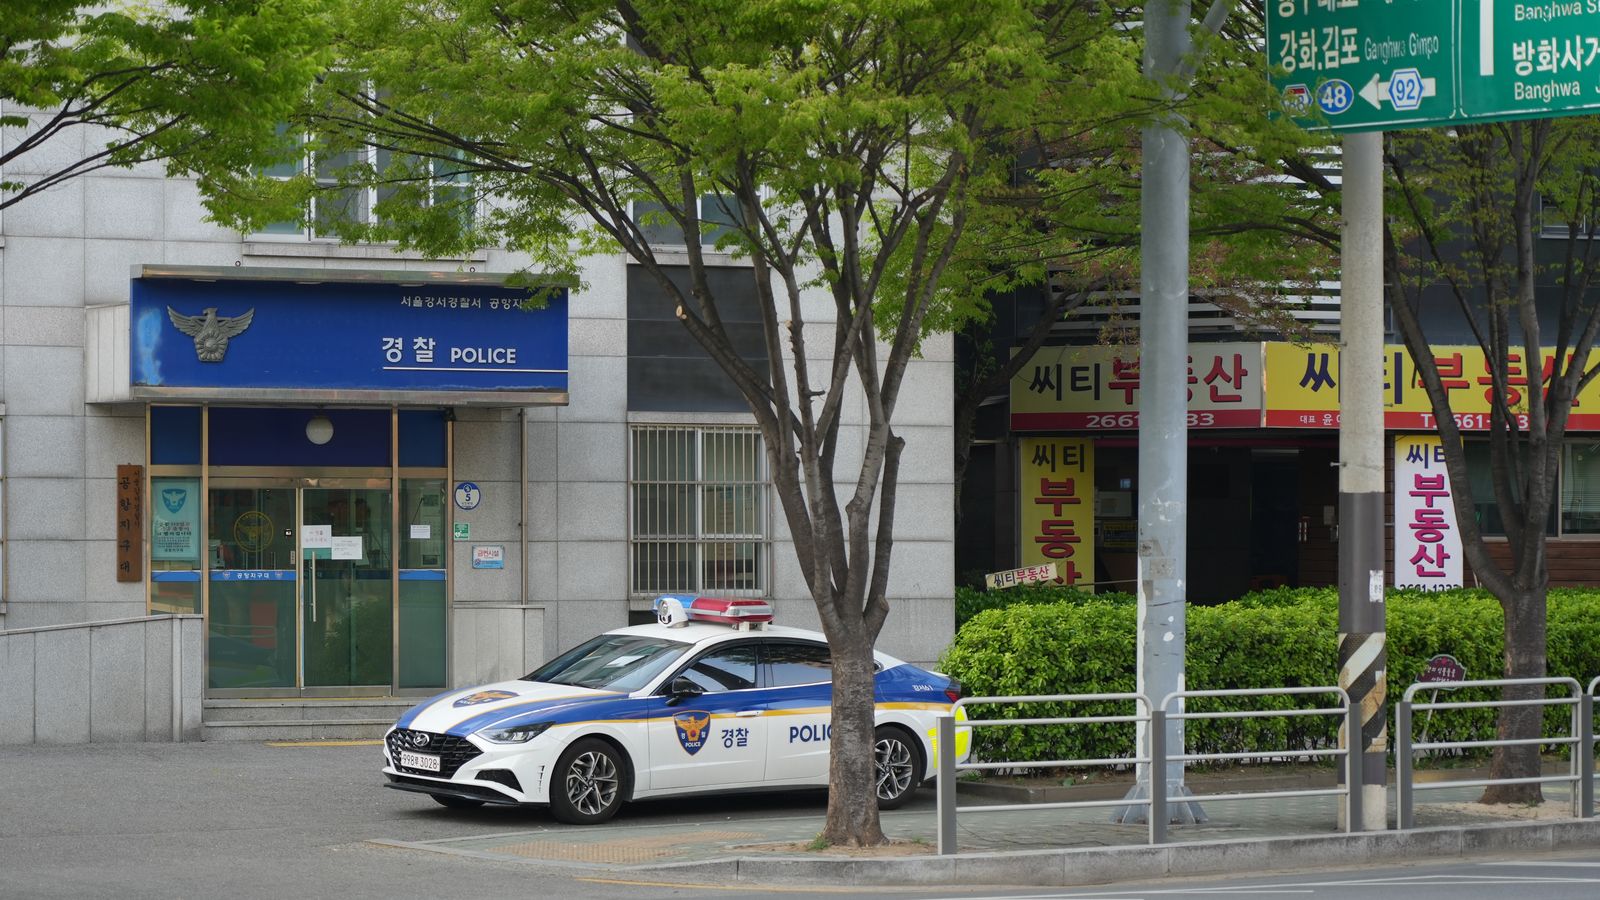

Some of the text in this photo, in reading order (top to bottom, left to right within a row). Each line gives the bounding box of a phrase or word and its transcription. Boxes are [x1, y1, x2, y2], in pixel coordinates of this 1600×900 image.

[1514, 1, 1582, 22] Banghwa
[1364, 32, 1440, 64] Ganghwa Gimpo
[1321, 85, 1346, 109] 48
[1396, 78, 1416, 102] 92
[1514, 80, 1581, 103] Banghwa
[400, 296, 481, 309] 서울강서경찰서
[382, 337, 517, 364] 경찰 POLICE
[1029, 353, 1248, 405] 씨티부산
[1300, 415, 1316, 424] 대표
[1032, 443, 1085, 472] 씨티
[465, 493, 471, 502] 5
[119, 476, 131, 573] 공항지구대
[1408, 473, 1450, 577] 부동산
[993, 565, 1050, 588] 씨티부동산
[721, 727, 749, 748] 경찰
[789, 723, 832, 743] POLI
